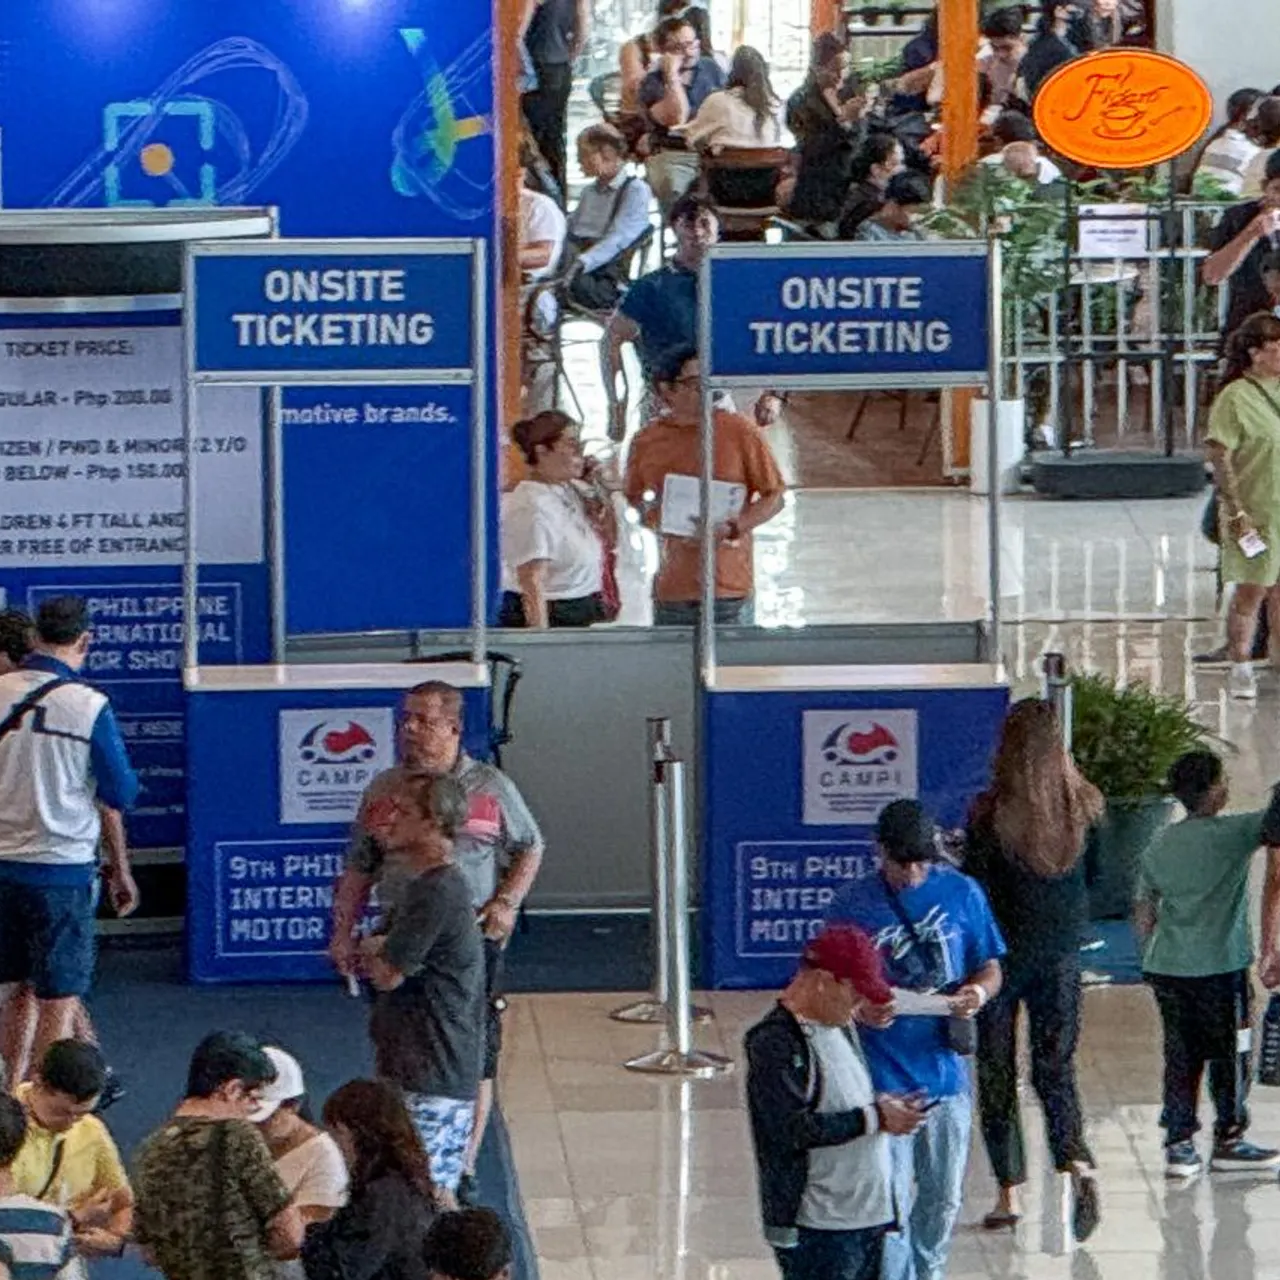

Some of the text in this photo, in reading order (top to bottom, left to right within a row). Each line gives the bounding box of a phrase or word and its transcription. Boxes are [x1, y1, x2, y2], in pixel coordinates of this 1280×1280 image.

[264, 269, 406, 303] ONSITE
[781, 276, 923, 310] ONSITE
[232, 313, 436, 347] TICKETING
[749, 320, 952, 354] TICKETING
[5, 340, 68, 357] TICKET
[277, 403, 360, 425] motive
[59, 439, 101, 455] PWD
[4, 464, 70, 481] BELOW
[72, 513, 95, 530] FT
[98, 512, 144, 529] TALL
[18, 538, 66, 555] FREE
[70, 537, 94, 554] OF
[98, 536, 187, 553] ENTRANC
[229, 915, 325, 943] MOTOR
